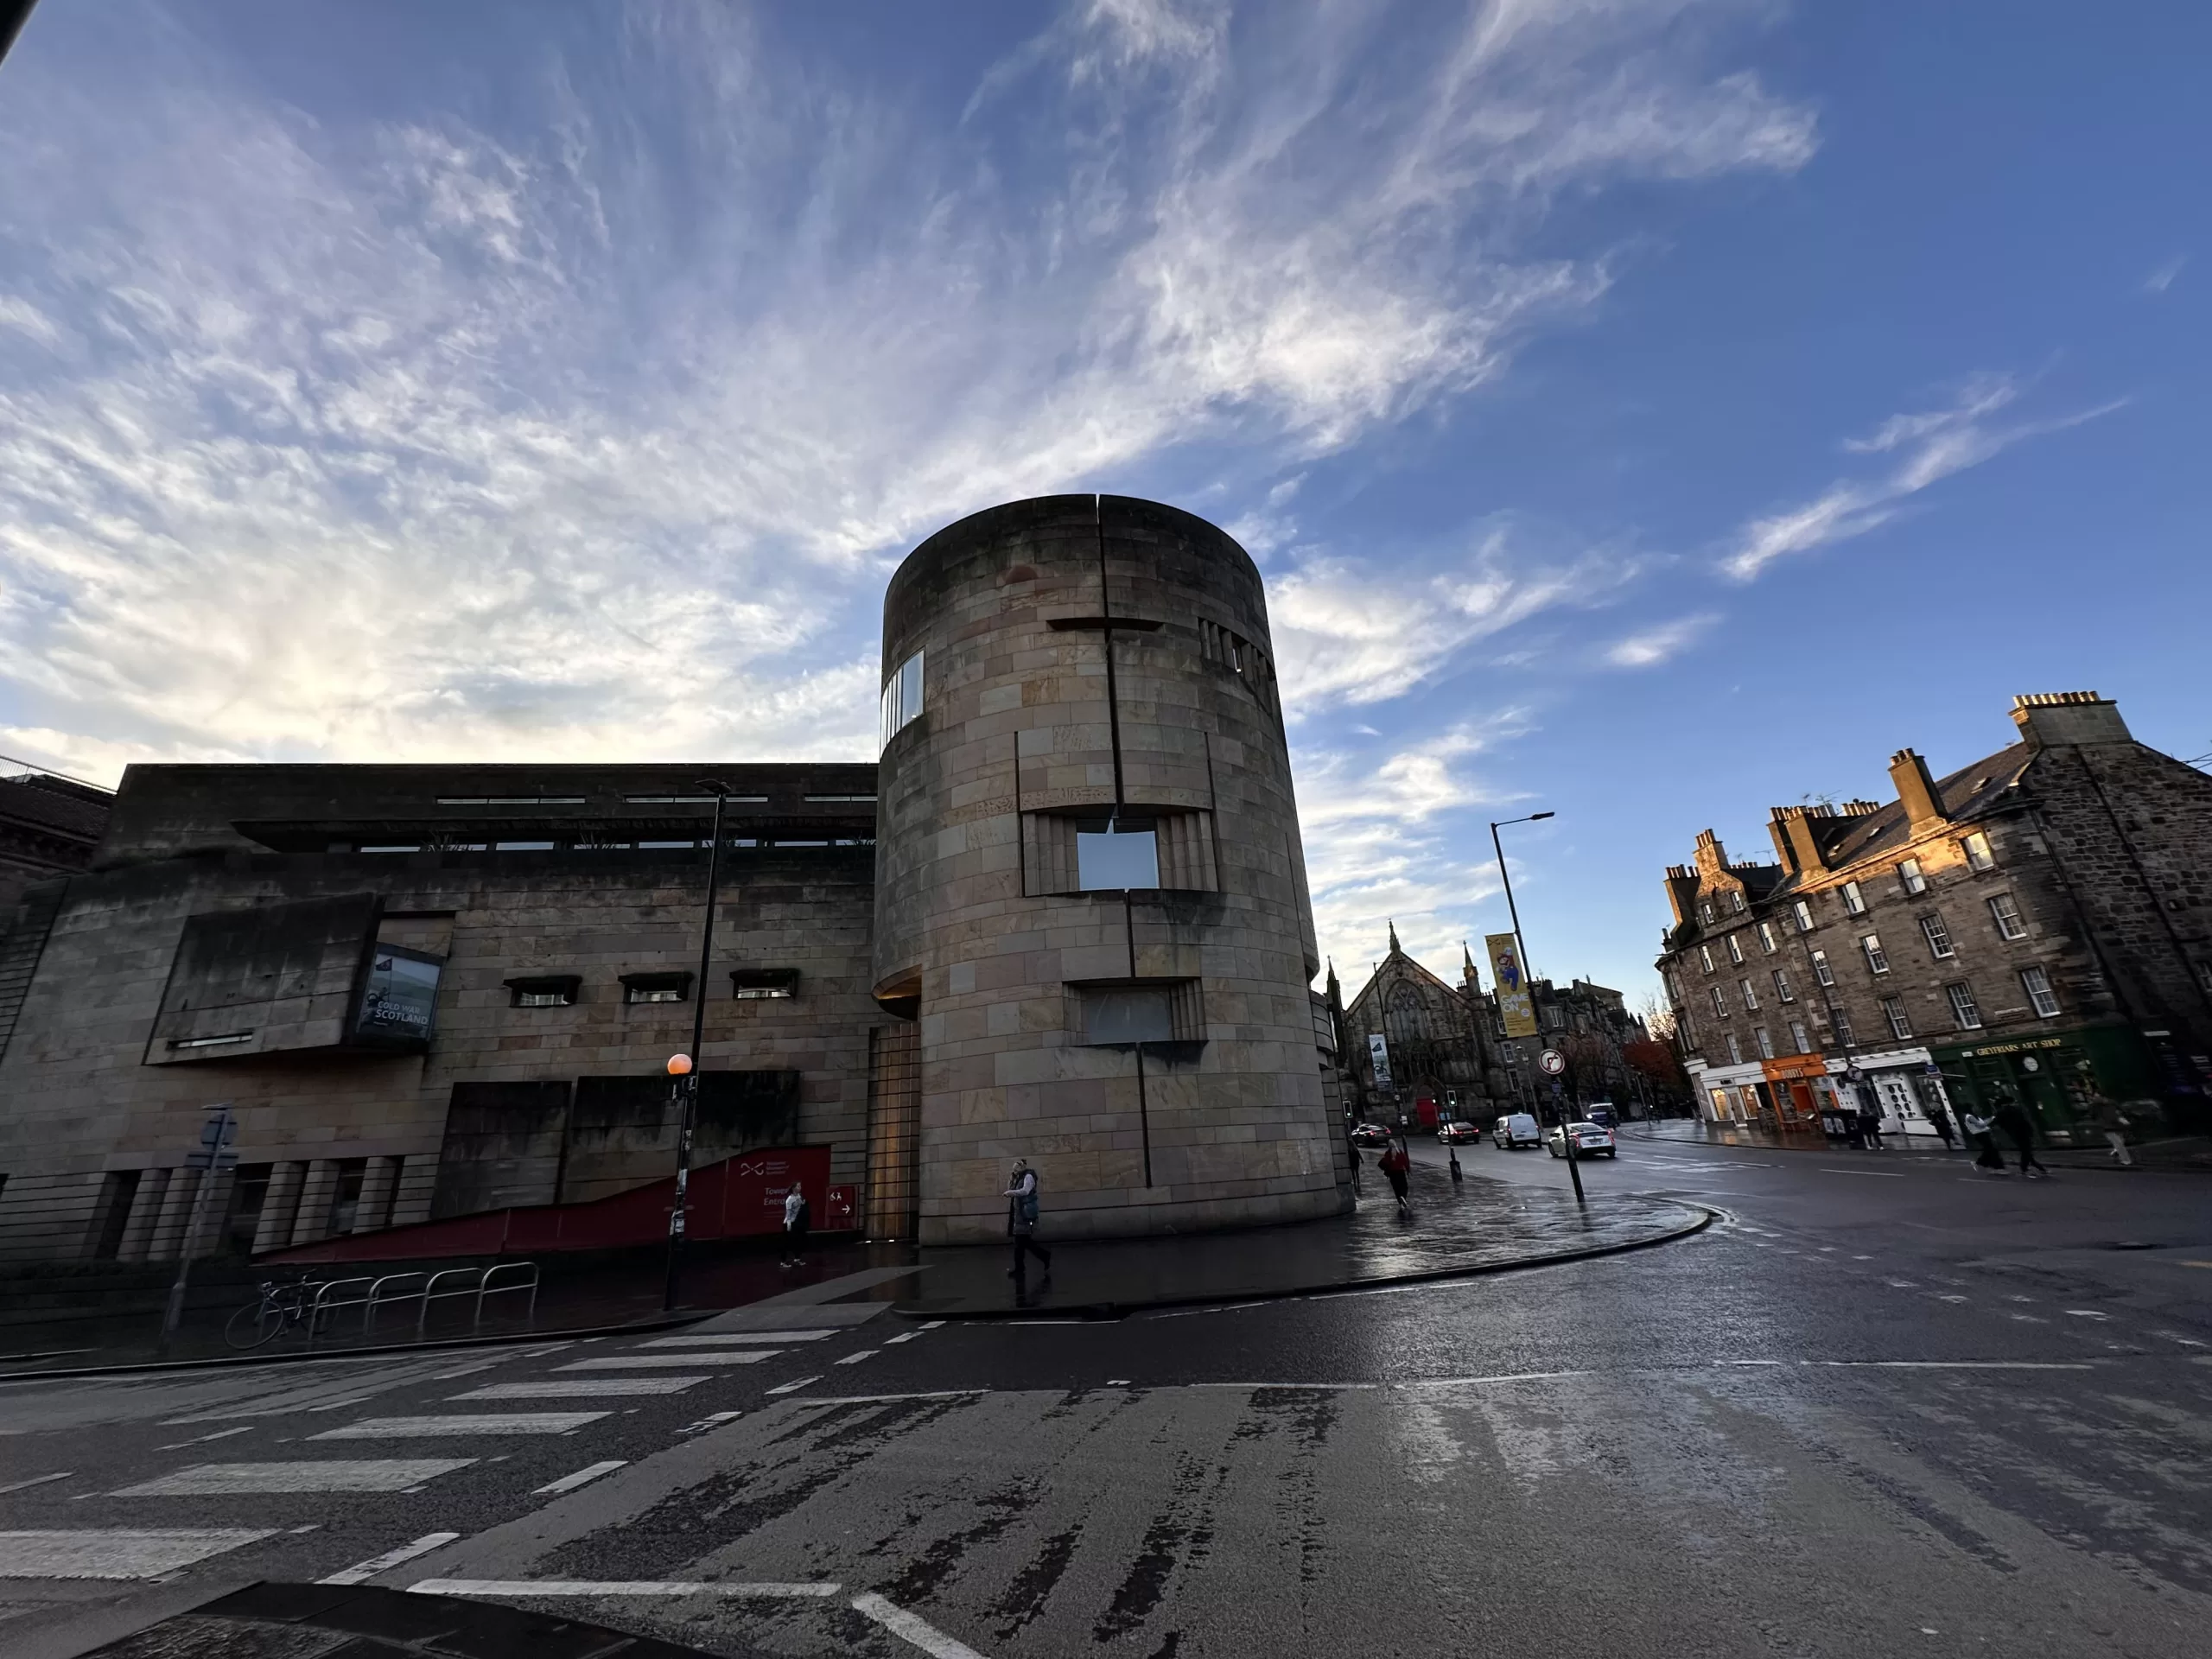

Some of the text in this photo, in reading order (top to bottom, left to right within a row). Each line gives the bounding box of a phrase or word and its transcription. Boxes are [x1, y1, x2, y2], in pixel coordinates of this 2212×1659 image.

[1501, 993, 1529, 1004] GAME
[378, 1001, 421, 1014] COLD WAR
[1503, 1003, 1519, 1013] ON
[375, 1009, 429, 1025] SCOTLAND
[1976, 1045, 2019, 1056] GREYFRIARS
[2041, 1039, 2062, 1048] SHOP
[764, 1198, 787, 1206] Entra
